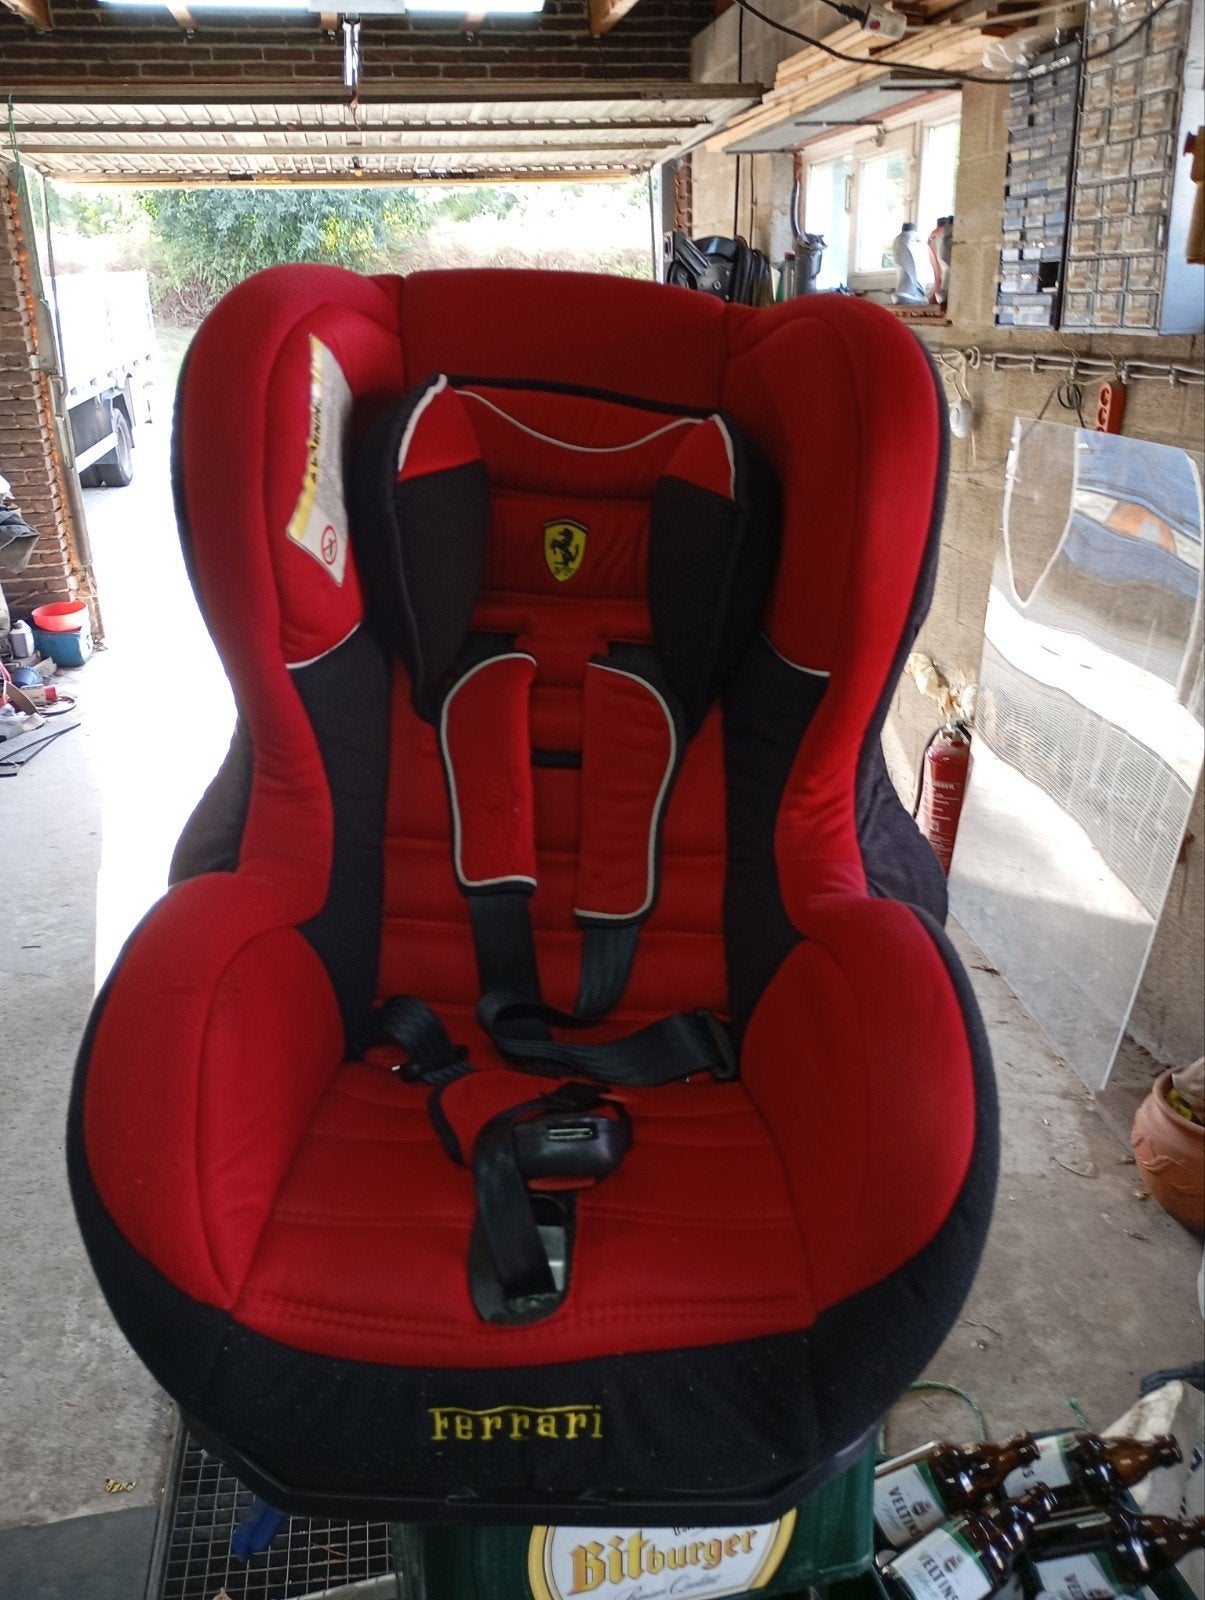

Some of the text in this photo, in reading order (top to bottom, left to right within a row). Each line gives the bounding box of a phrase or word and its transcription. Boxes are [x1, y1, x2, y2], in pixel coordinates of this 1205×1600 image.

[428, 1405, 603, 1441] Ferrari
[889, 1486, 921, 1538] VELTIN
[567, 1529, 758, 1596] Bitburger
